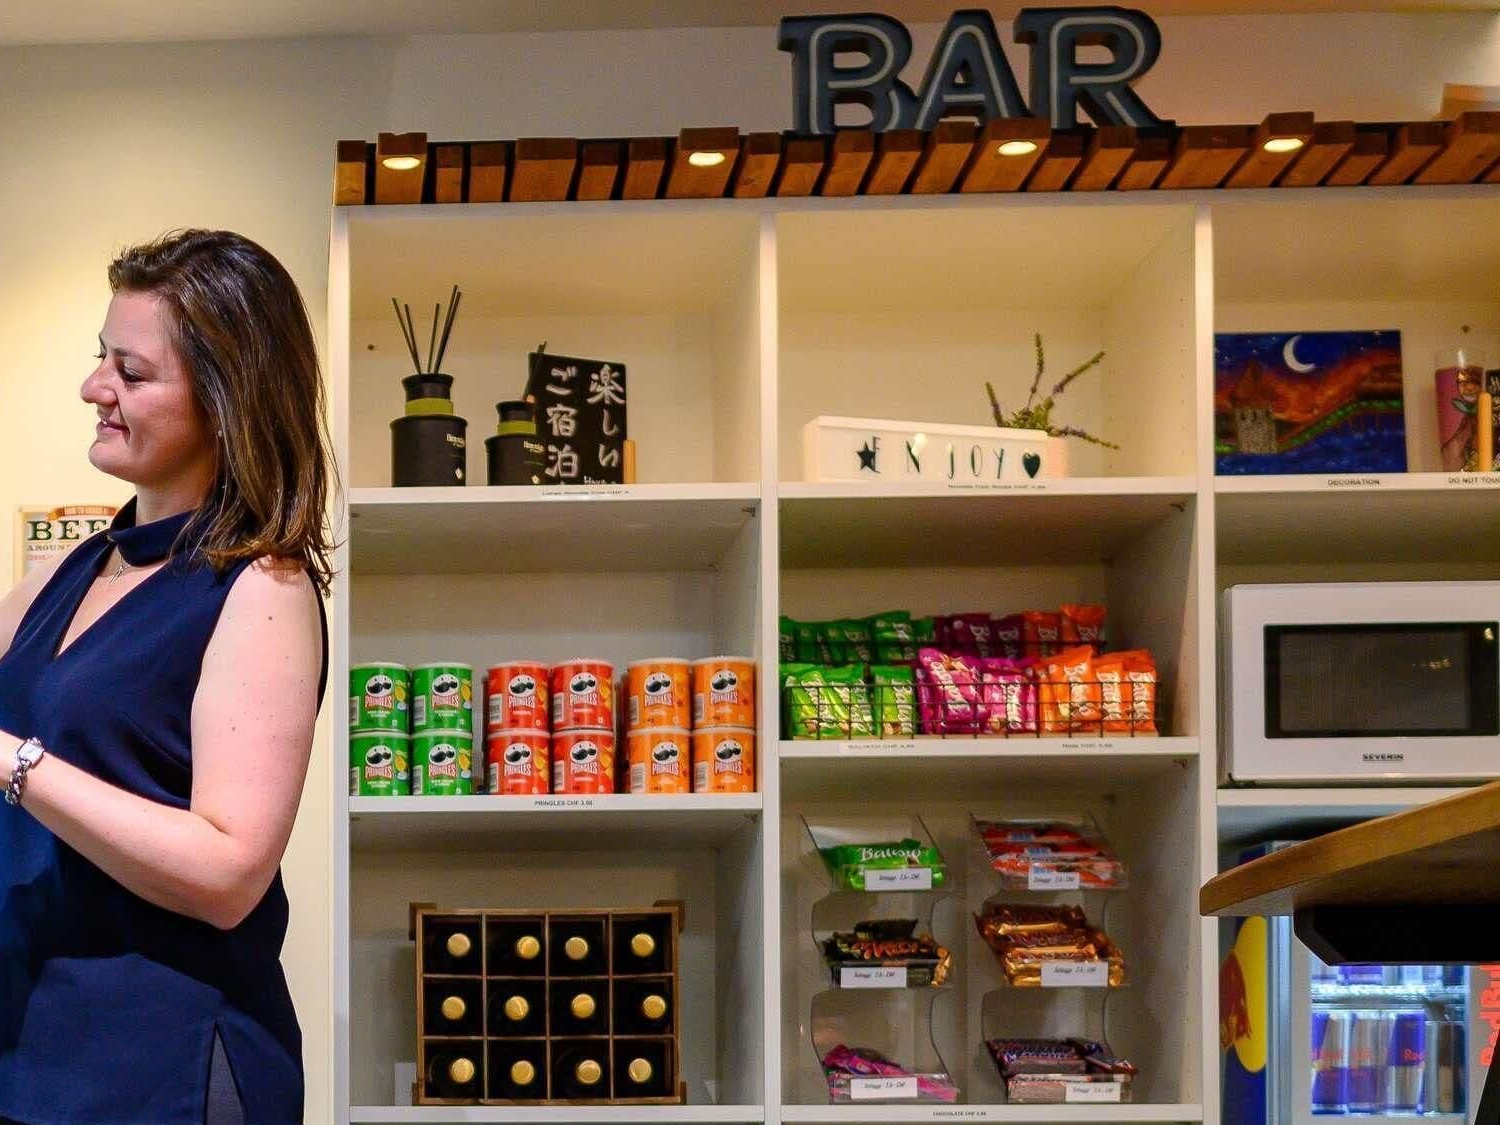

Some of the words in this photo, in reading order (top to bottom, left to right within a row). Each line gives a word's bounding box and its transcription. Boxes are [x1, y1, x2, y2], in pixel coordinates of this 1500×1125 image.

[778, 6, 1176, 134] BAR
[587, 364, 625, 467] 楽しい
[27, 544, 70, 552] AROUN
